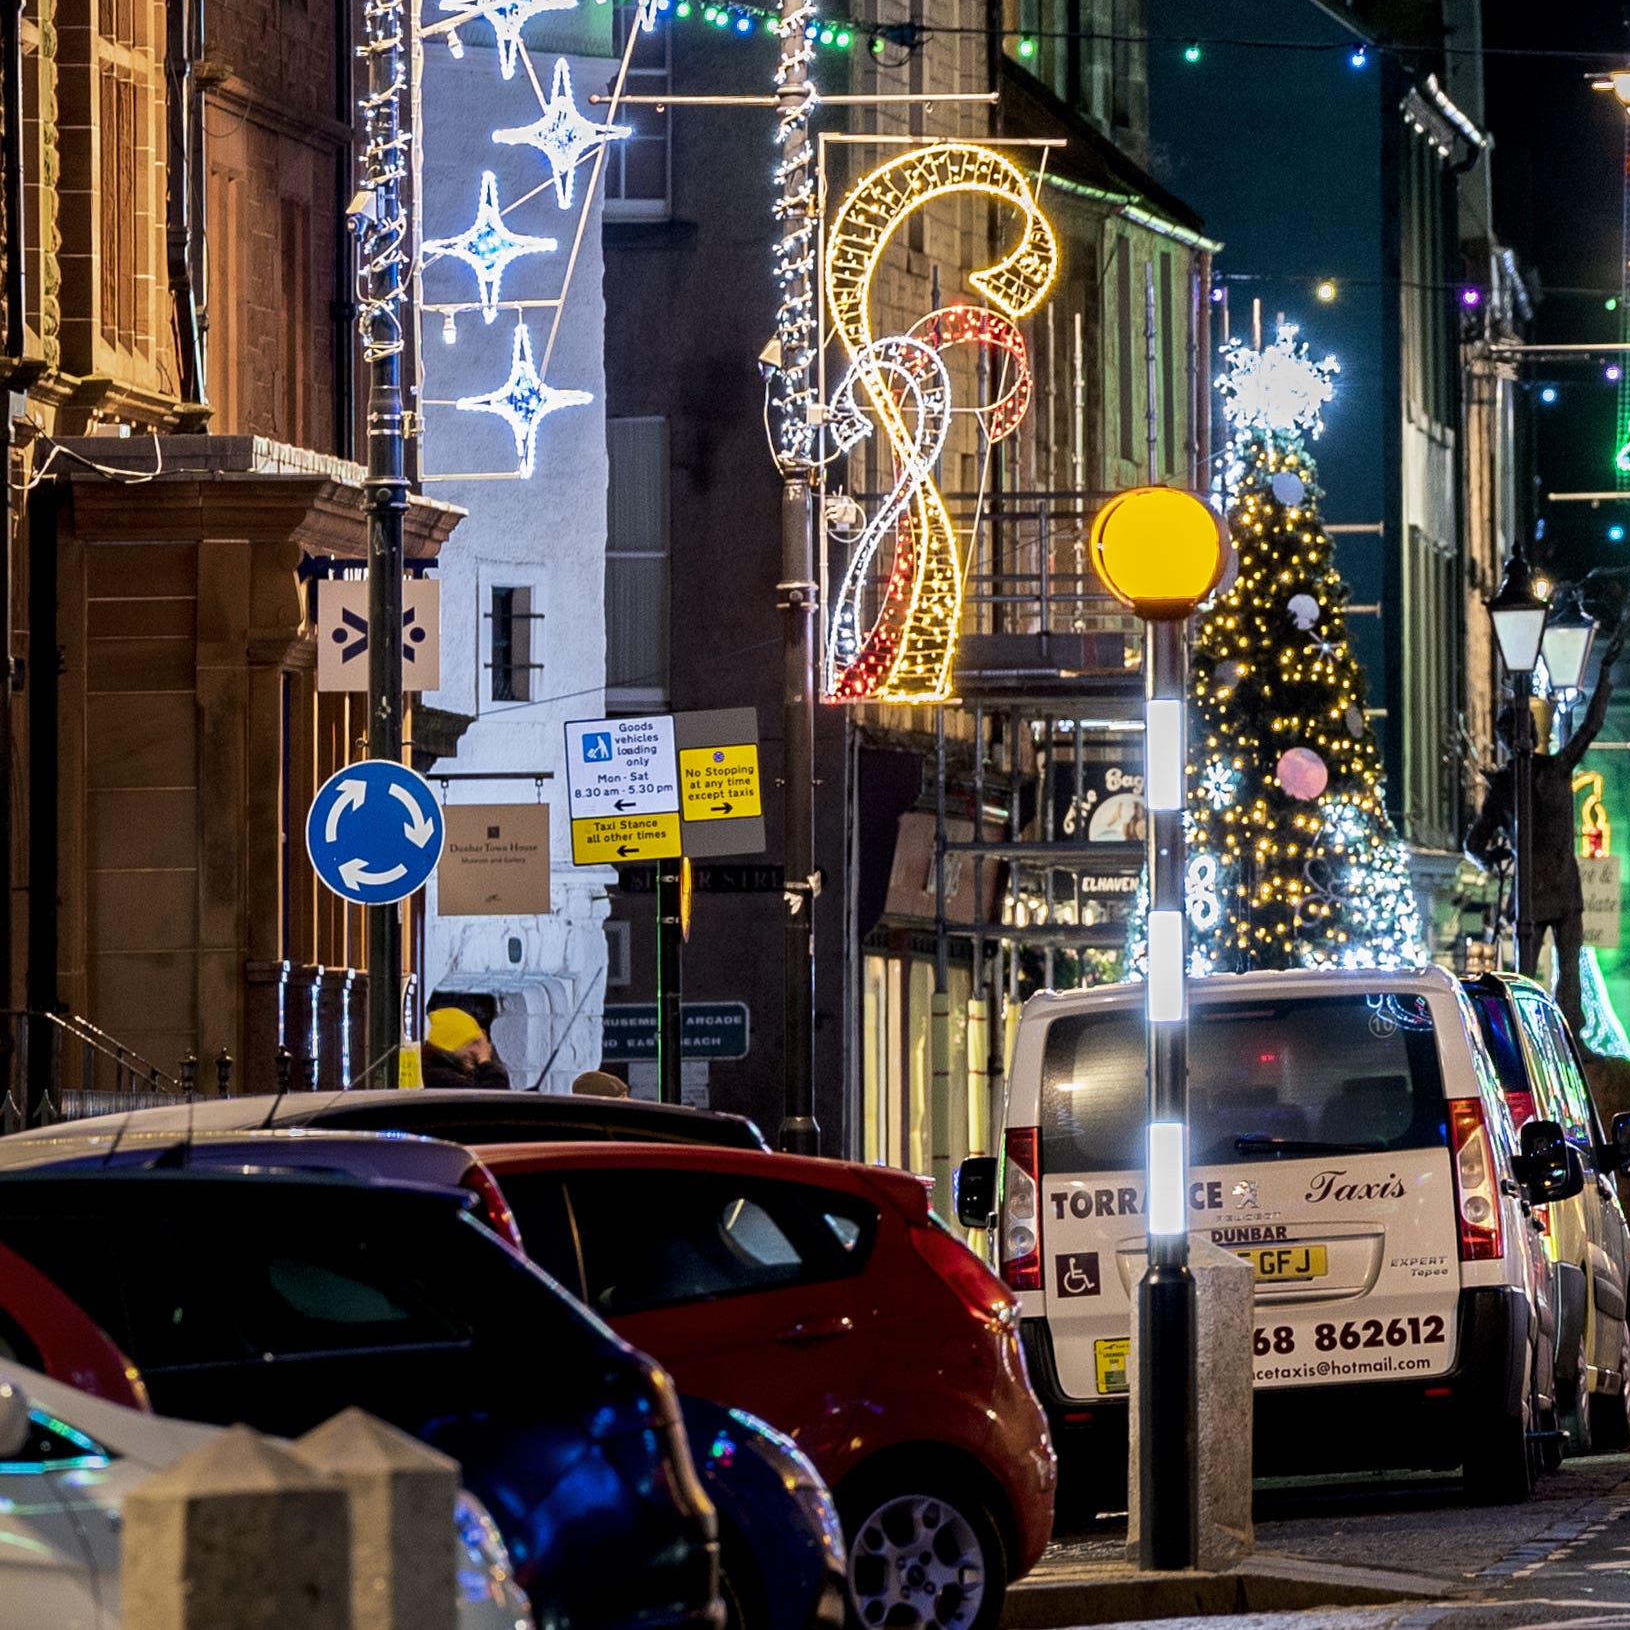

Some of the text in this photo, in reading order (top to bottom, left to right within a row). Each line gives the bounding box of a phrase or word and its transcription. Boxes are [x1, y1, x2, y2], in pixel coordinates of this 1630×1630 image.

[618, 722, 654, 733] Goods
[614, 732, 660, 745] vehicles
[616, 744, 658, 756] loading
[626, 757, 650, 768] only
[597, 774, 621, 784] Mon
[630, 771, 649, 781] Sat
[685, 765, 755, 778] No Stopping
[689, 777, 751, 790] at any time
[574, 788, 601, 798] 8.30
[603, 788, 620, 797] am
[628, 784, 655, 794] 5.30
[656, 784, 674, 794] pm
[687, 786, 755, 802] except taxis
[593, 819, 659, 831] Taxi Stance
[586, 829, 667, 843] all other times
[449, 842, 539, 853] Dunbar Town House
[685, 1015, 743, 1026] ARCADE
[1304, 1169, 1408, 1204] Taxis
[1210, 1225, 1288, 1244] DUNBAR
[1389, 1255, 1449, 1268] EXPERT
[1314, 1314, 1446, 1352] 862612
